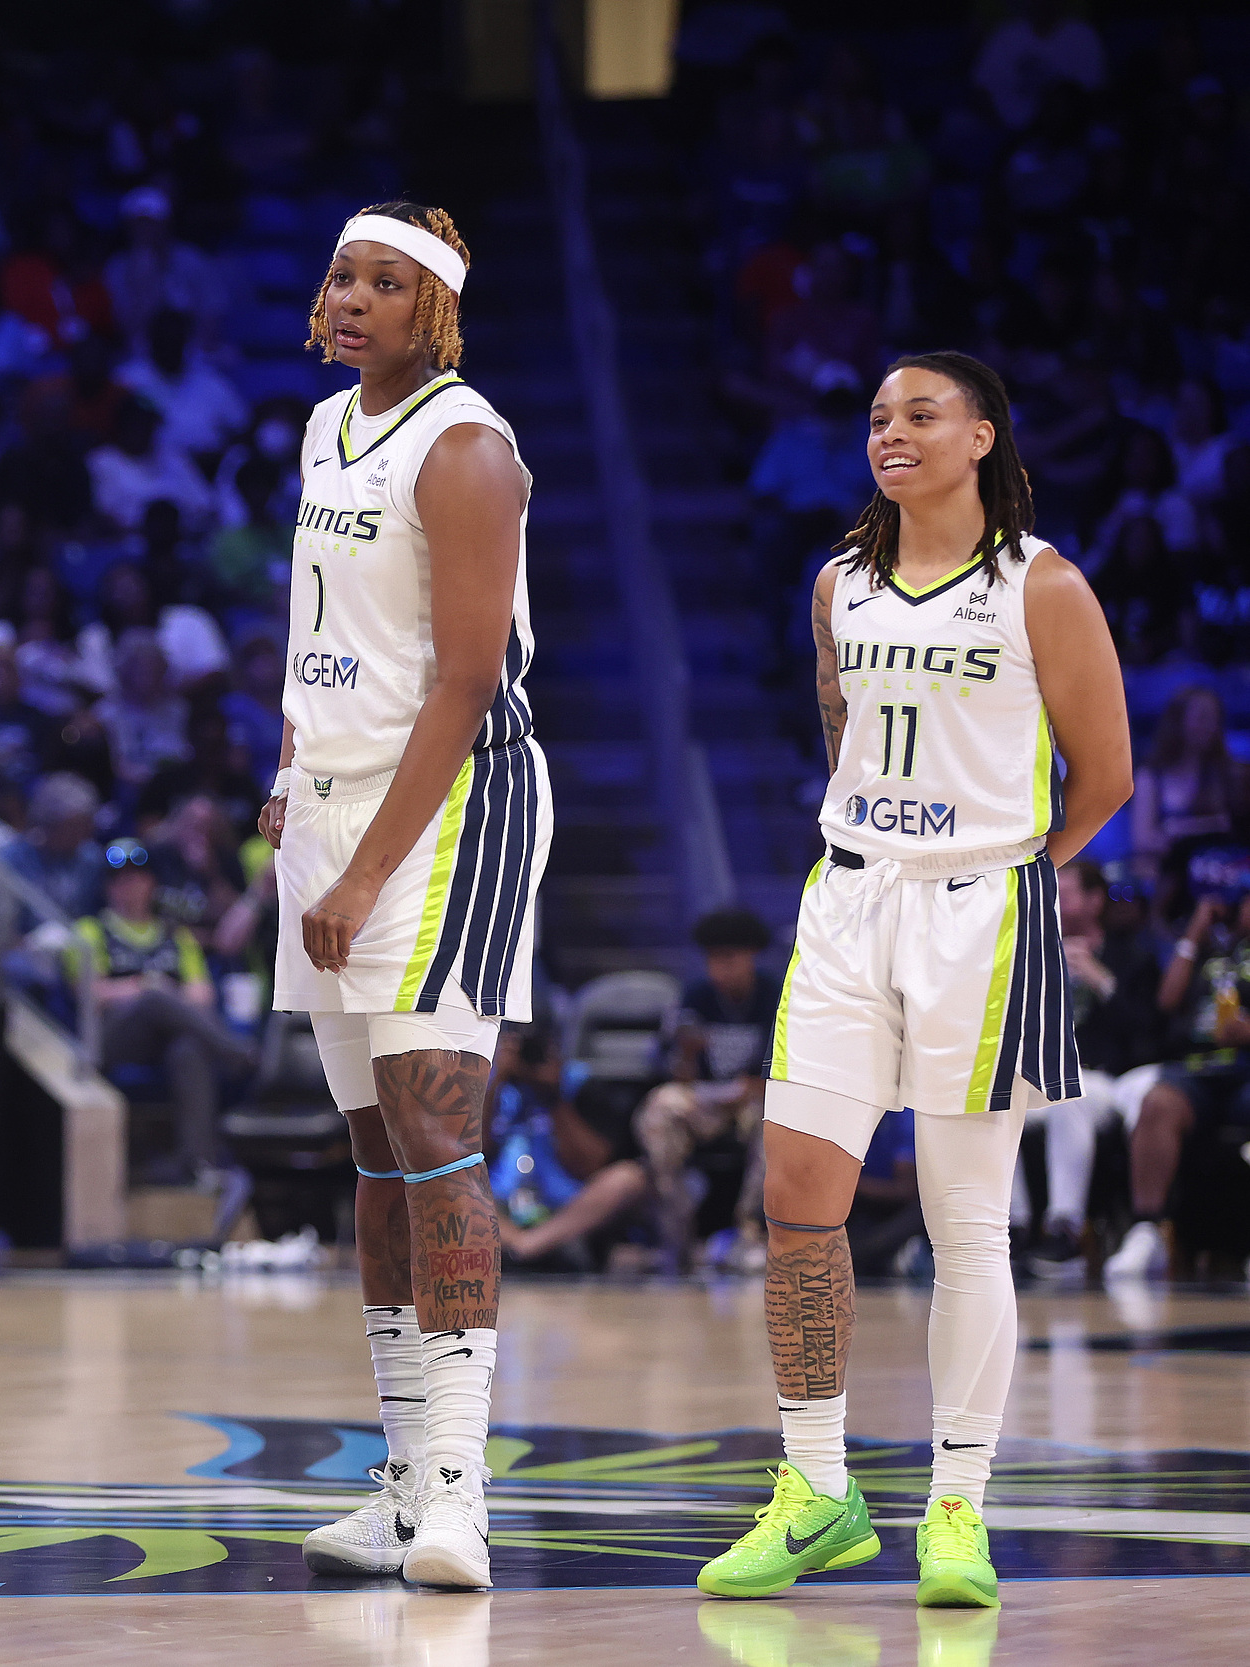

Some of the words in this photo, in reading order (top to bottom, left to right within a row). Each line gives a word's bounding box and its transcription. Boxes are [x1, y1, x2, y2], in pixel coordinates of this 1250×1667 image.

[366, 473, 386, 487] Albert
[310, 561, 326, 636] 1
[953, 607, 997, 624] Albert
[301, 652, 359, 690] GEM
[836, 638, 1005, 684] WINGS
[877, 702, 921, 781] 11
[870, 797, 956, 837] GEM
[436, 1212, 470, 1249] MY
[434, 1278, 486, 1308] KEEPER
